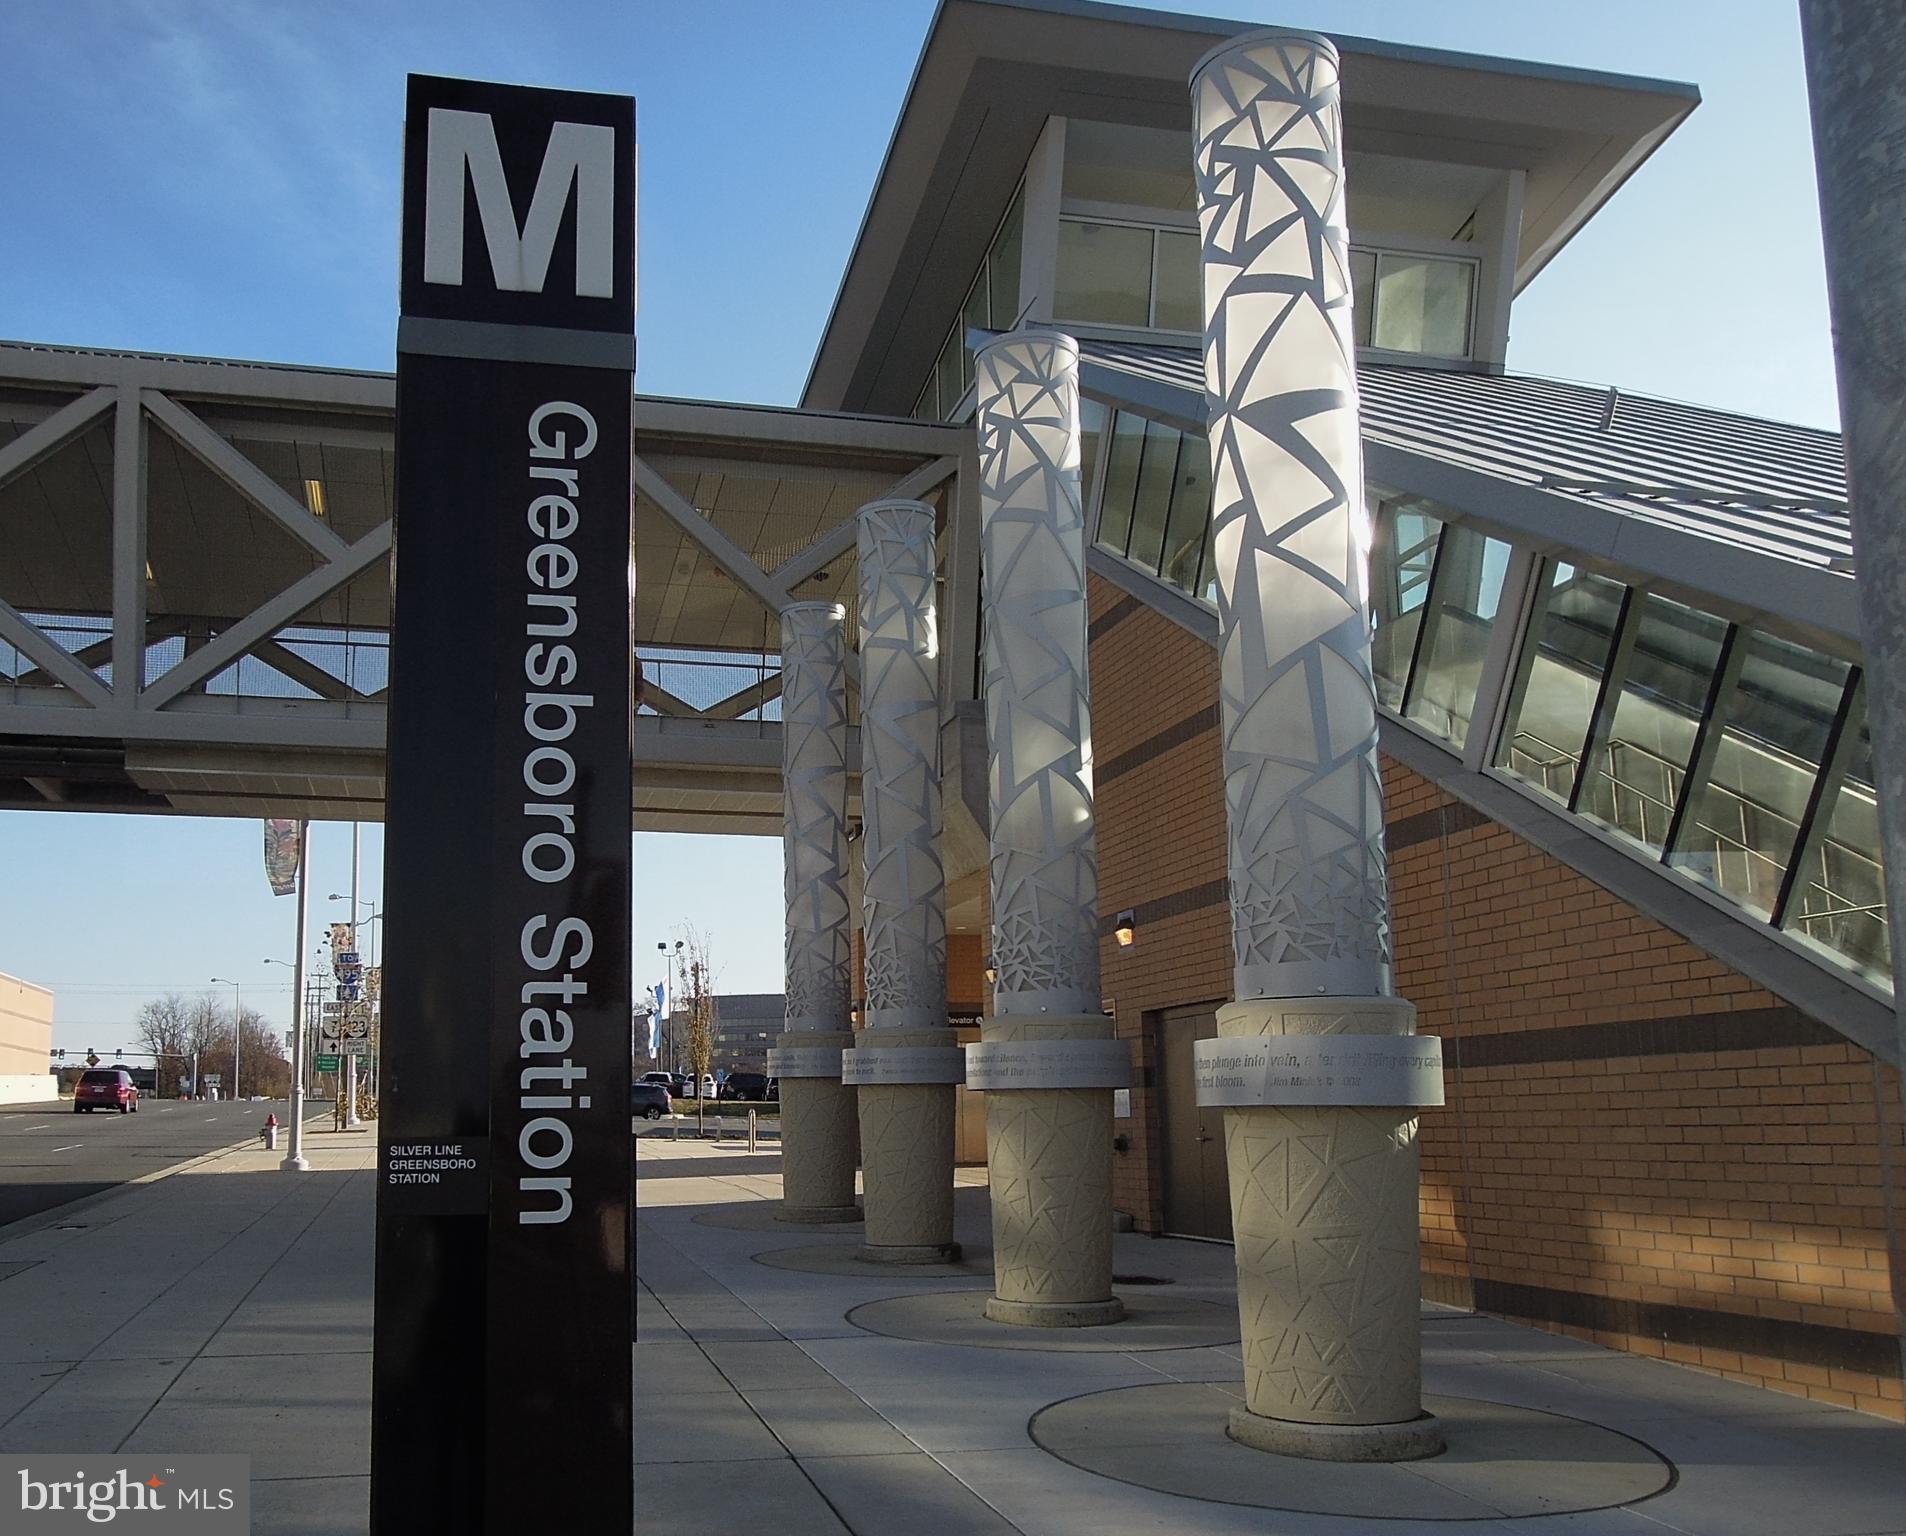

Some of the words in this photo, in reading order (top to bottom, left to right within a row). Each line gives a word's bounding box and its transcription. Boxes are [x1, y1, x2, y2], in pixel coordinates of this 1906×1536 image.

[422, 107, 616, 298] M
[523, 400, 598, 884] Greensboro
[1244, 1054, 1265, 1068] into
[517, 912, 593, 1225] Station
[390, 1145, 431, 1156] SILVER
[435, 1145, 462, 1156] LINE
[389, 1159, 476, 1170] GREENSBORO
[389, 1173, 440, 1184] STATION
